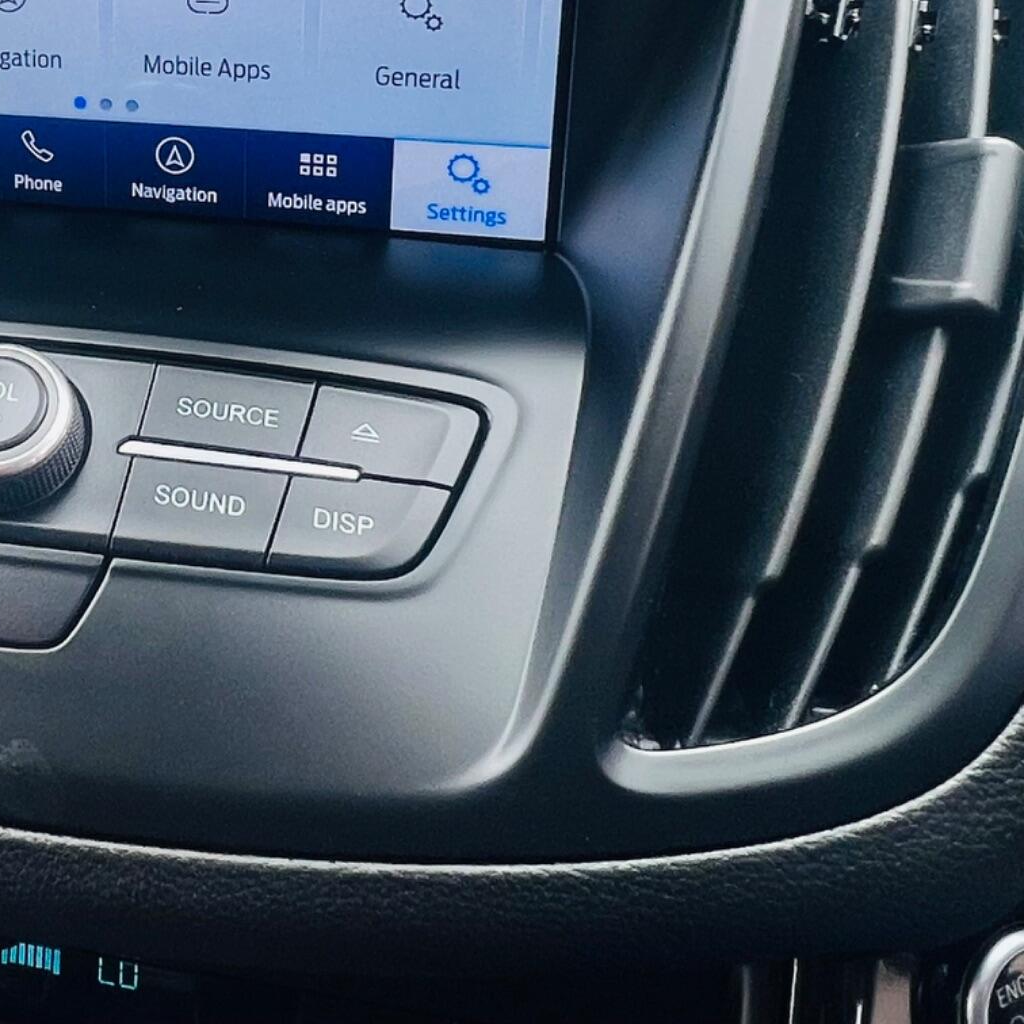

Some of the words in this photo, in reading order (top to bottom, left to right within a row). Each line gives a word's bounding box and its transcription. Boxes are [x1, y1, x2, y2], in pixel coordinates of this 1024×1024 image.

[143, 54, 213, 77] Mobile
[217, 58, 271, 83] Apps
[375, 66, 461, 90] General
[13, 173, 64, 193] Phone
[131, 182, 218, 205] Navigation
[267, 191, 323, 213] Mobile
[324, 197, 367, 216] apps
[426, 203, 507, 228] Settings
[176, 395, 280, 429] SOURCE
[153, 485, 246, 518] SOUND
[312, 506, 375, 536] DISP
